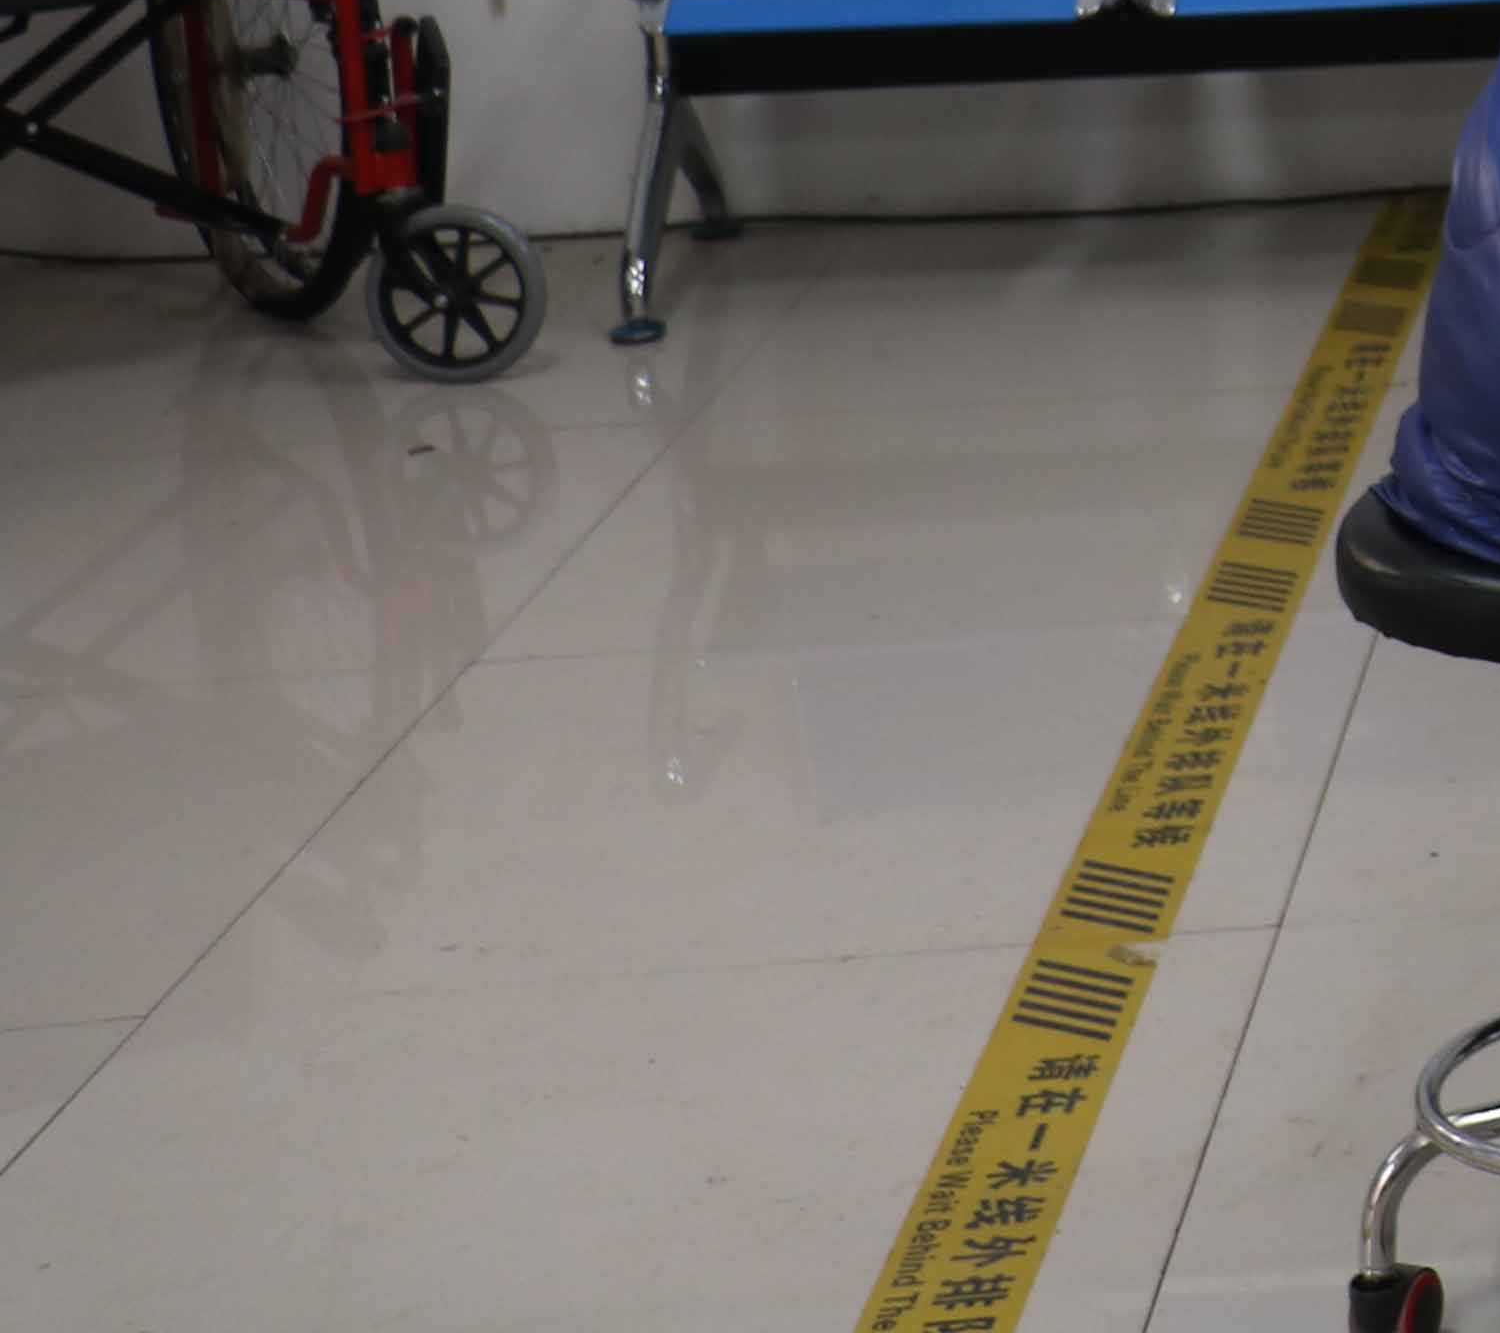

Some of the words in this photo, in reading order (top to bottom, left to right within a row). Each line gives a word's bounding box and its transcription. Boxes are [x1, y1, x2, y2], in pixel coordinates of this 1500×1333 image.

[946, 1109, 999, 1166] Please
[923, 1170, 973, 1216] Wait
[891, 1219, 952, 1287] Behind
[872, 1292, 919, 1332] The
